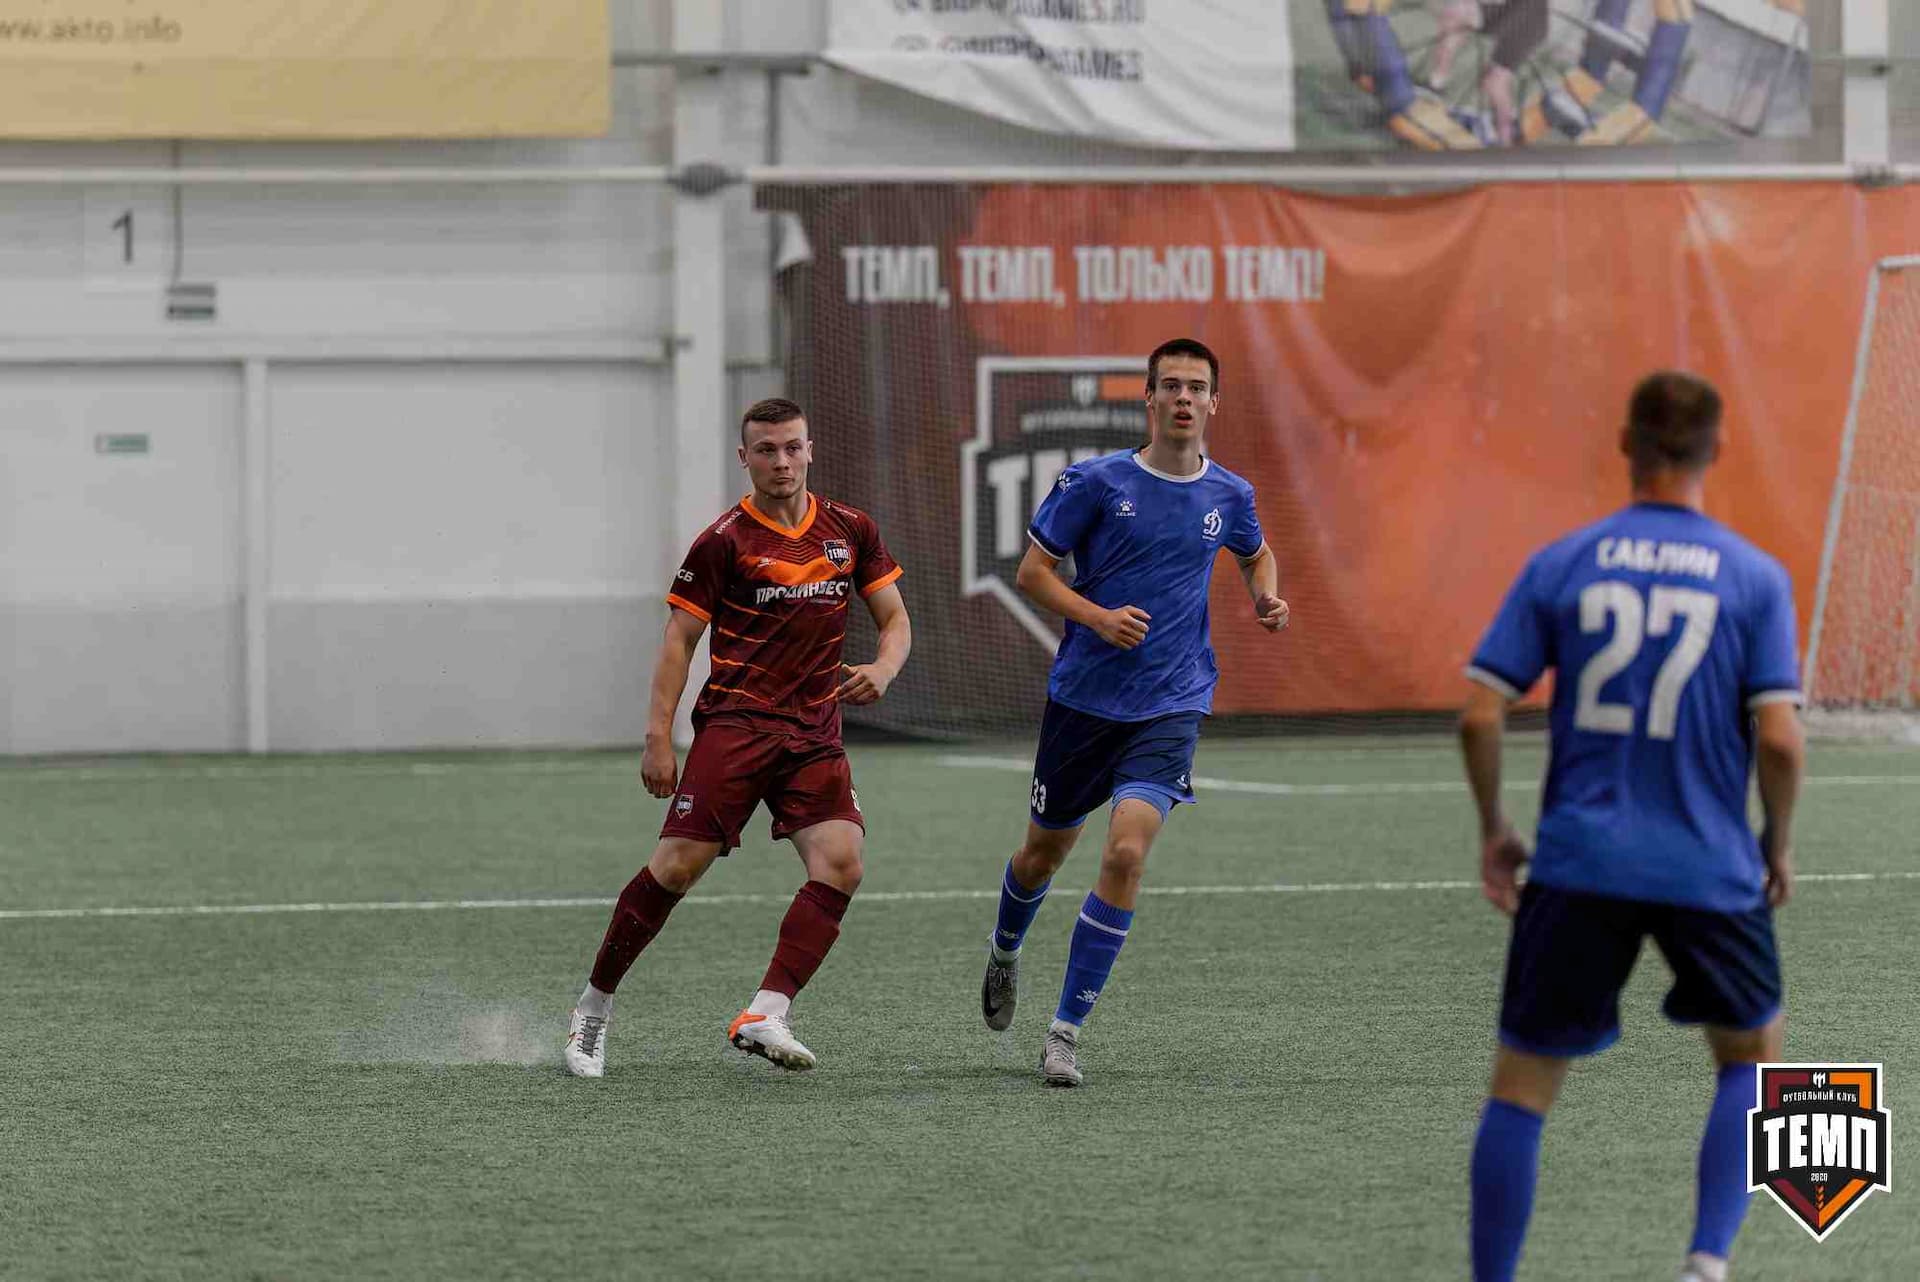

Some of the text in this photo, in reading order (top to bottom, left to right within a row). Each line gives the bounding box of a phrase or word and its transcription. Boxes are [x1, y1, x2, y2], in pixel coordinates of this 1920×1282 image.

[112, 209, 134, 264] 1
[842, 246, 1326, 308] ТЕМП, ТЕМП, ТОЛЬКО ТЕМП!
[1574, 579, 1720, 740] 27
[1031, 776, 1047, 814] 33
